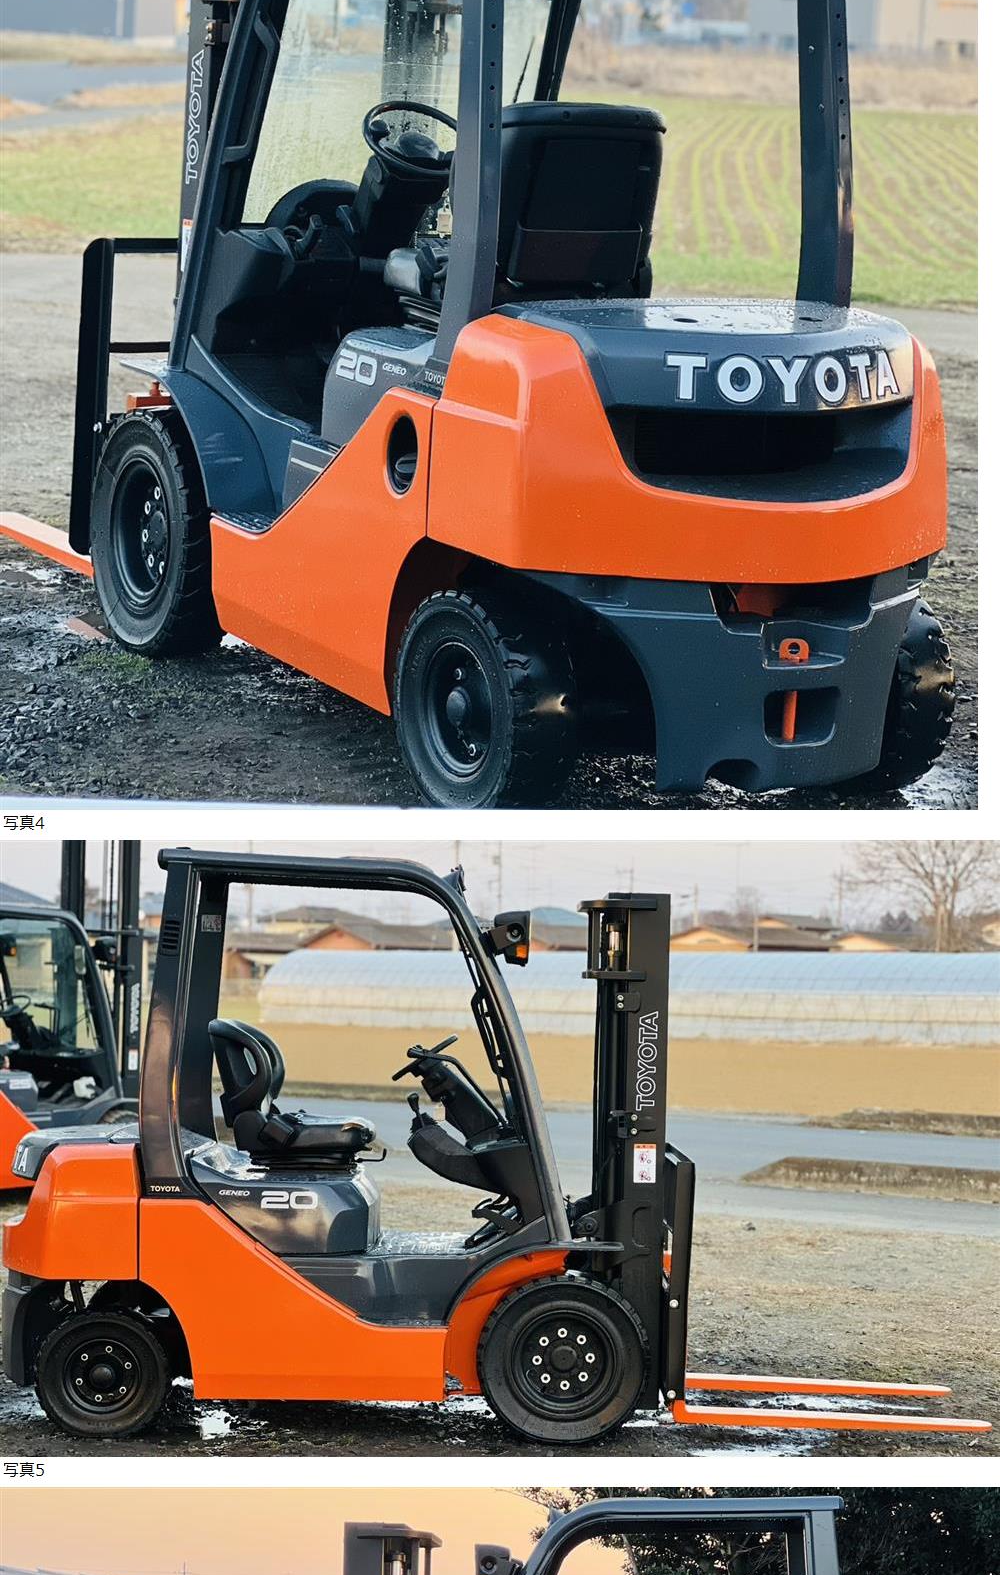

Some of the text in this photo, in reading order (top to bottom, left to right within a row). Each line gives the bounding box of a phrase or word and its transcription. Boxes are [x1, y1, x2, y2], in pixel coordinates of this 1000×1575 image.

[185, 49, 205, 184] TOYOTA
[335, 348, 407, 386] 20 GENEO
[424, 371, 446, 385] TOYOT
[666, 350, 899, 403] TOYOTA
[636, 1011, 659, 1111] TOYOTA
[150, 1185, 181, 1193] TOYOTA
[260, 1191, 319, 1209] 20
